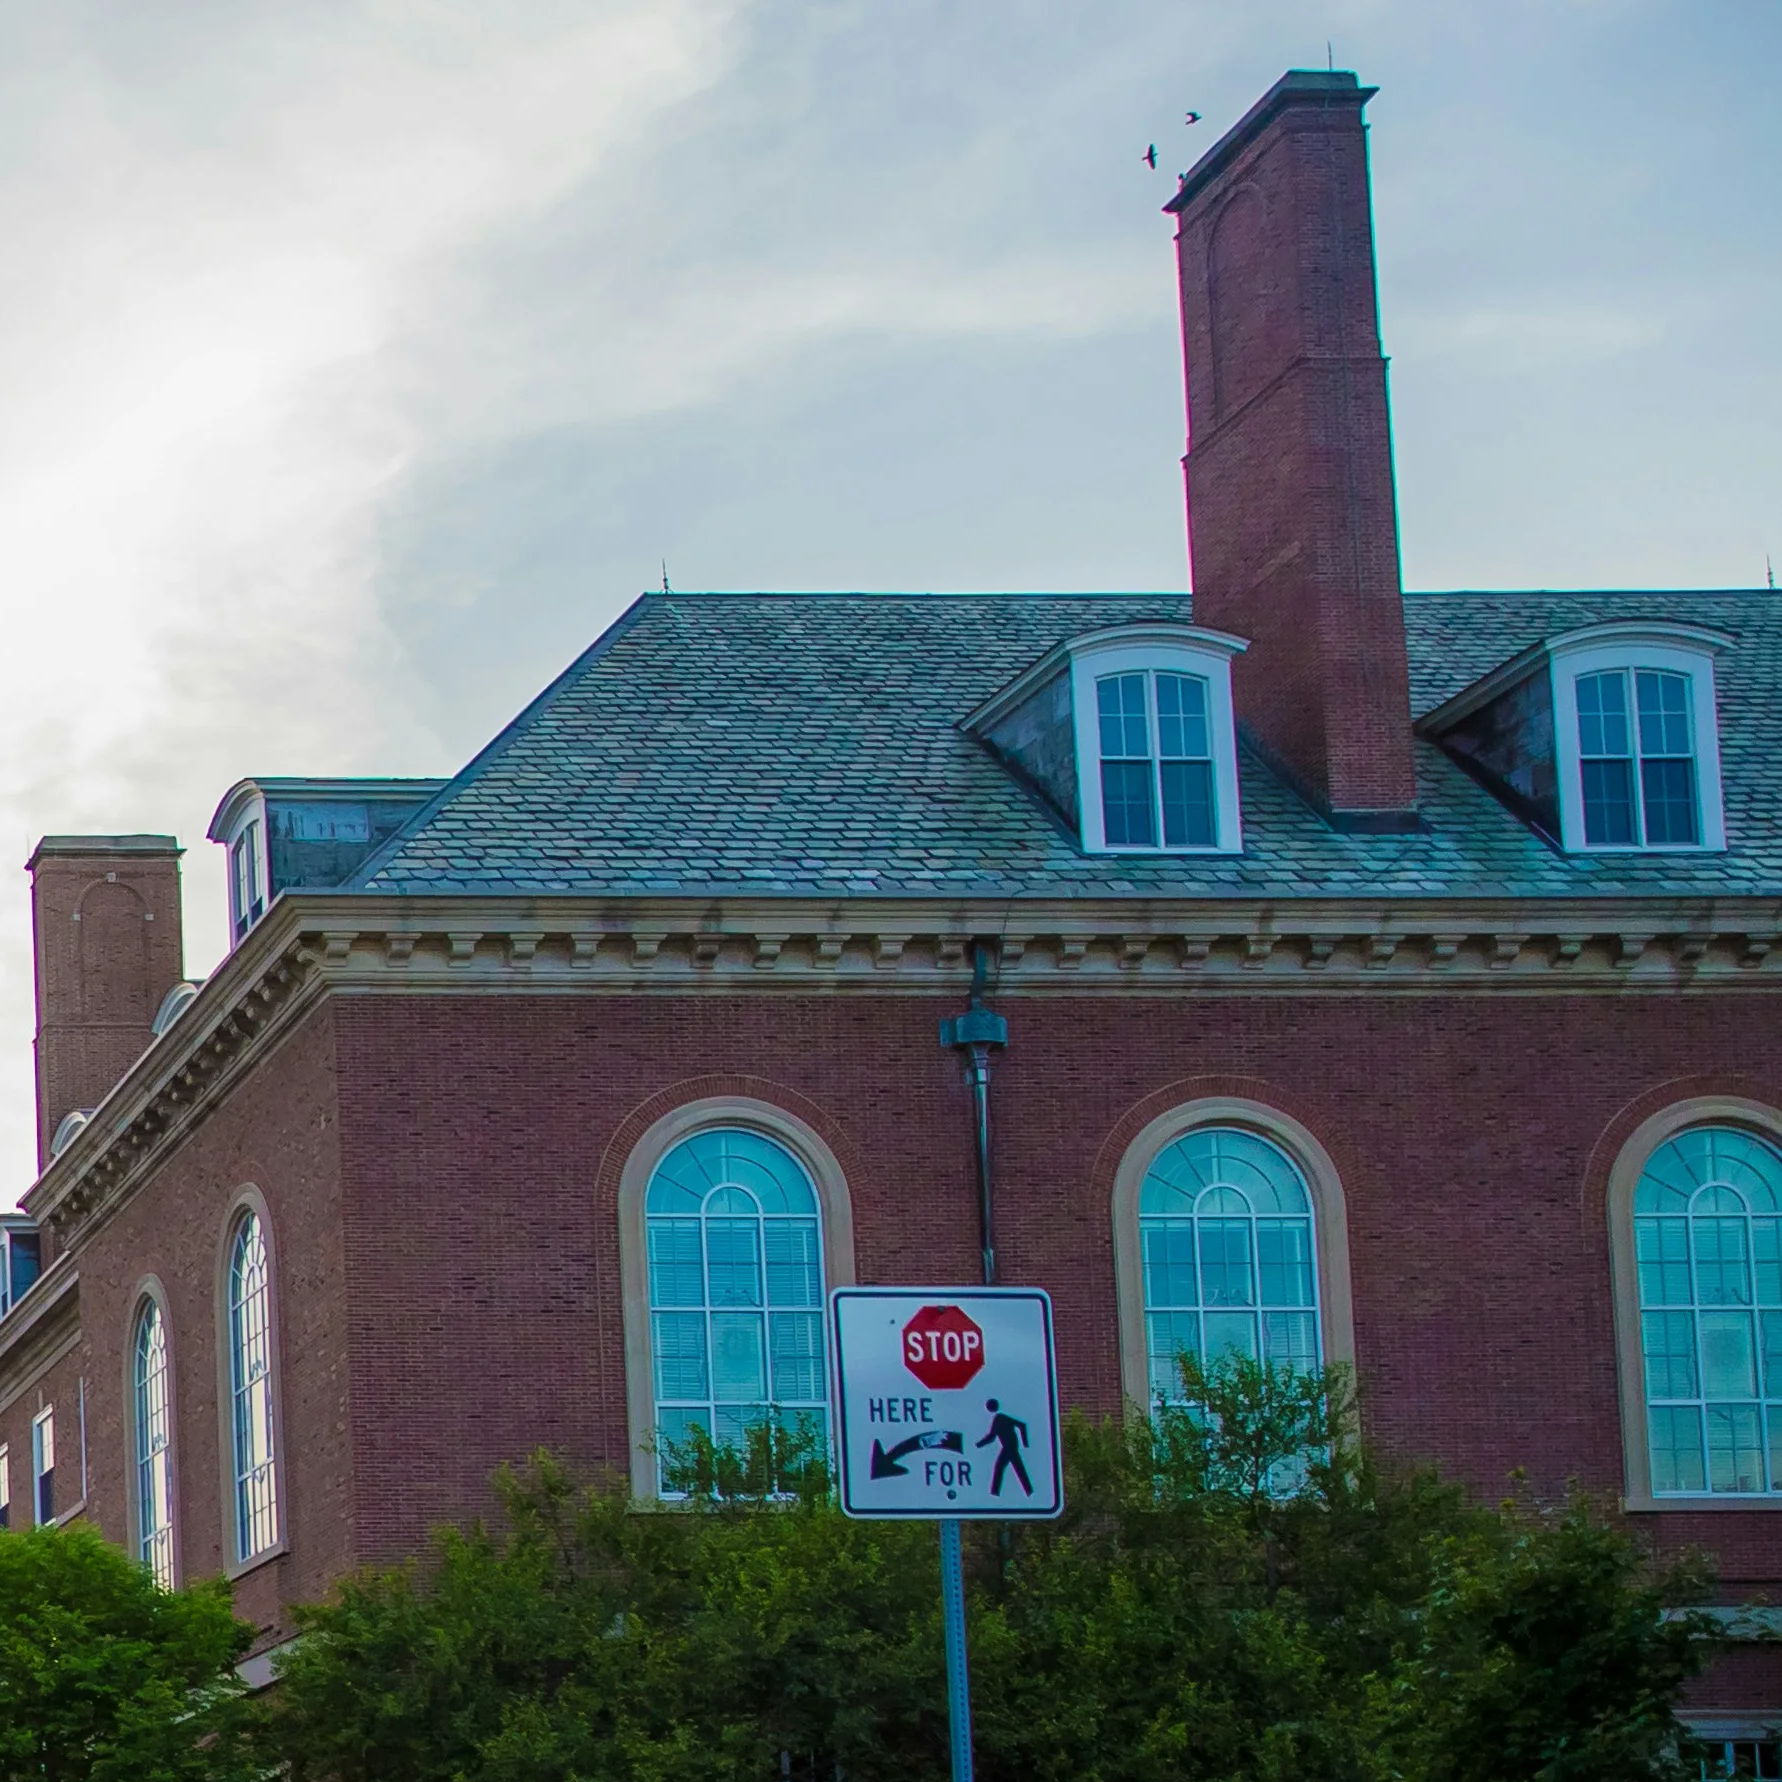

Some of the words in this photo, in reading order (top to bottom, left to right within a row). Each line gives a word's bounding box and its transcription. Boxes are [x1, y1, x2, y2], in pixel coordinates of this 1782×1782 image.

[907, 1331, 980, 1363] STOP
[869, 1398, 934, 1423] HERE
[925, 1461, 972, 1487] FOR
